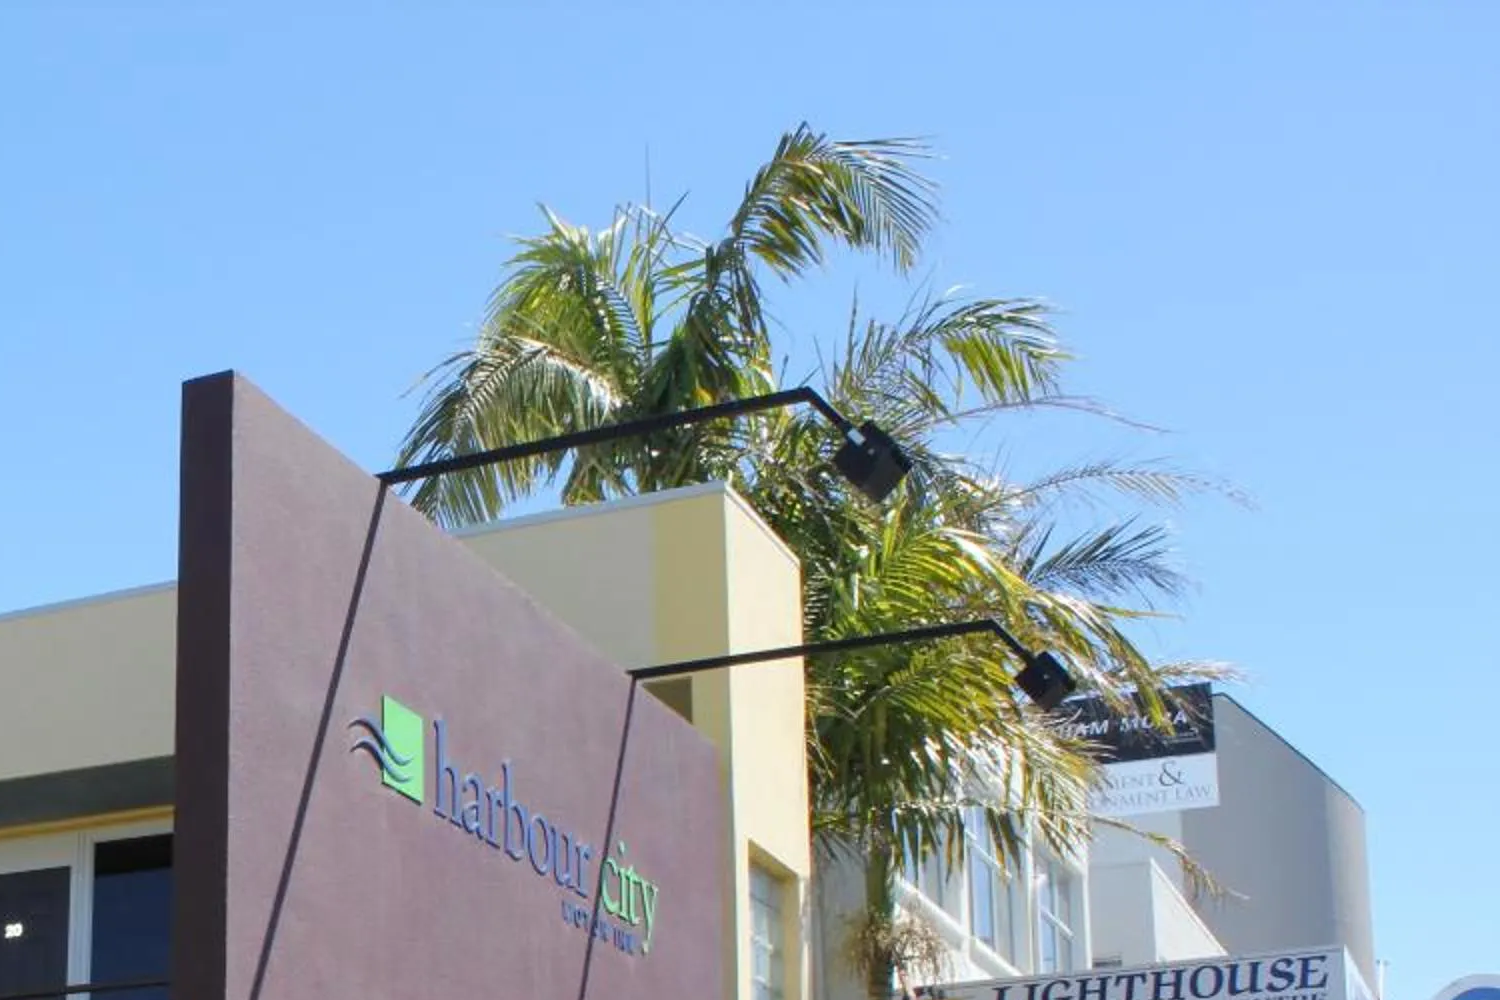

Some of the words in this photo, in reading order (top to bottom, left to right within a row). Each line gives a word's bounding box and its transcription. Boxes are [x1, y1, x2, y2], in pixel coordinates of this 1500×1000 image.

[1158, 759, 1186, 787] &
[1176, 783, 1212, 802] LAW
[432, 713, 596, 899] harbour
[599, 841, 660, 956] city
